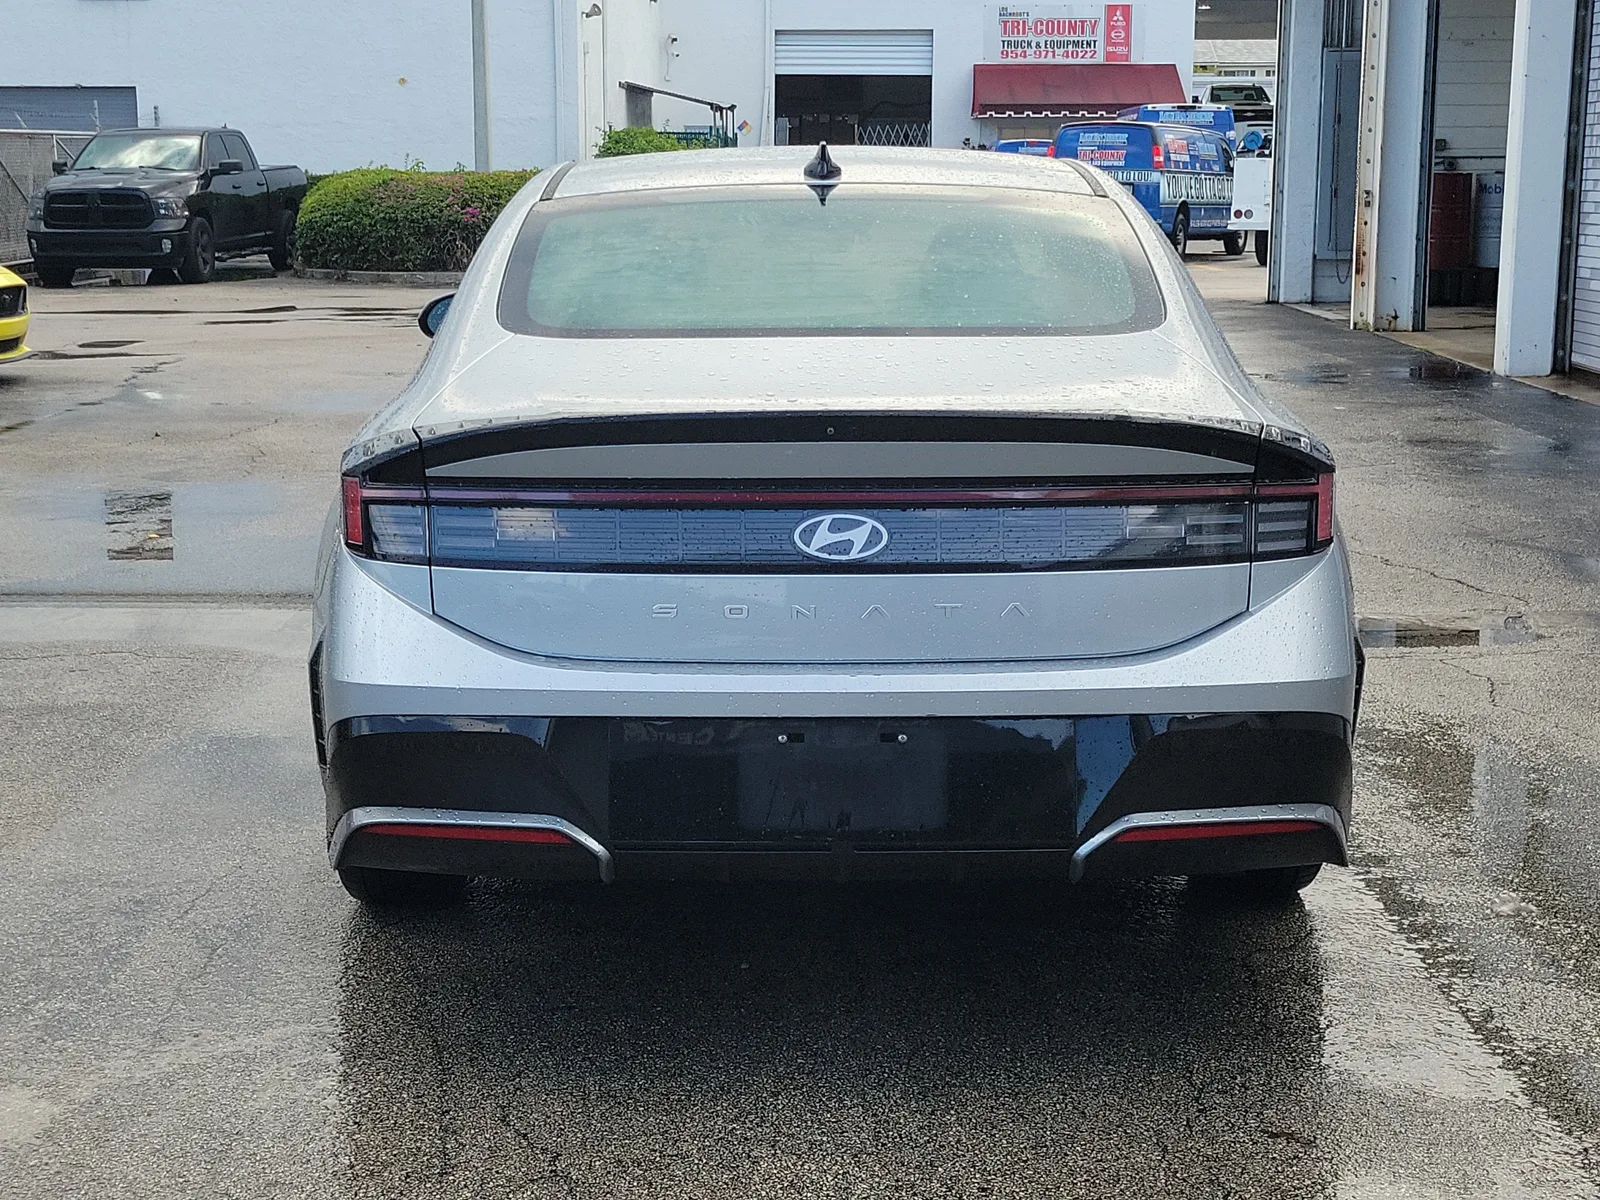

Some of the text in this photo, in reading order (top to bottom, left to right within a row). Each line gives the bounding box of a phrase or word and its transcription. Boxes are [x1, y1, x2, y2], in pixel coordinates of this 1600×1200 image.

[1000, 19, 1099, 36] TRI-COUNTY
[1001, 40, 1097, 50] TRUCK & EQUIPMENT
[1000, 50, 1097, 59] 954-971-4022
[1121, 171, 1131, 182] TO
[1133, 171, 1152, 182] LOU!
[1194, 176, 1217, 200] GOTTA
[1217, 177, 1226, 200] GO
[652, 602, 1030, 619] SONATA
